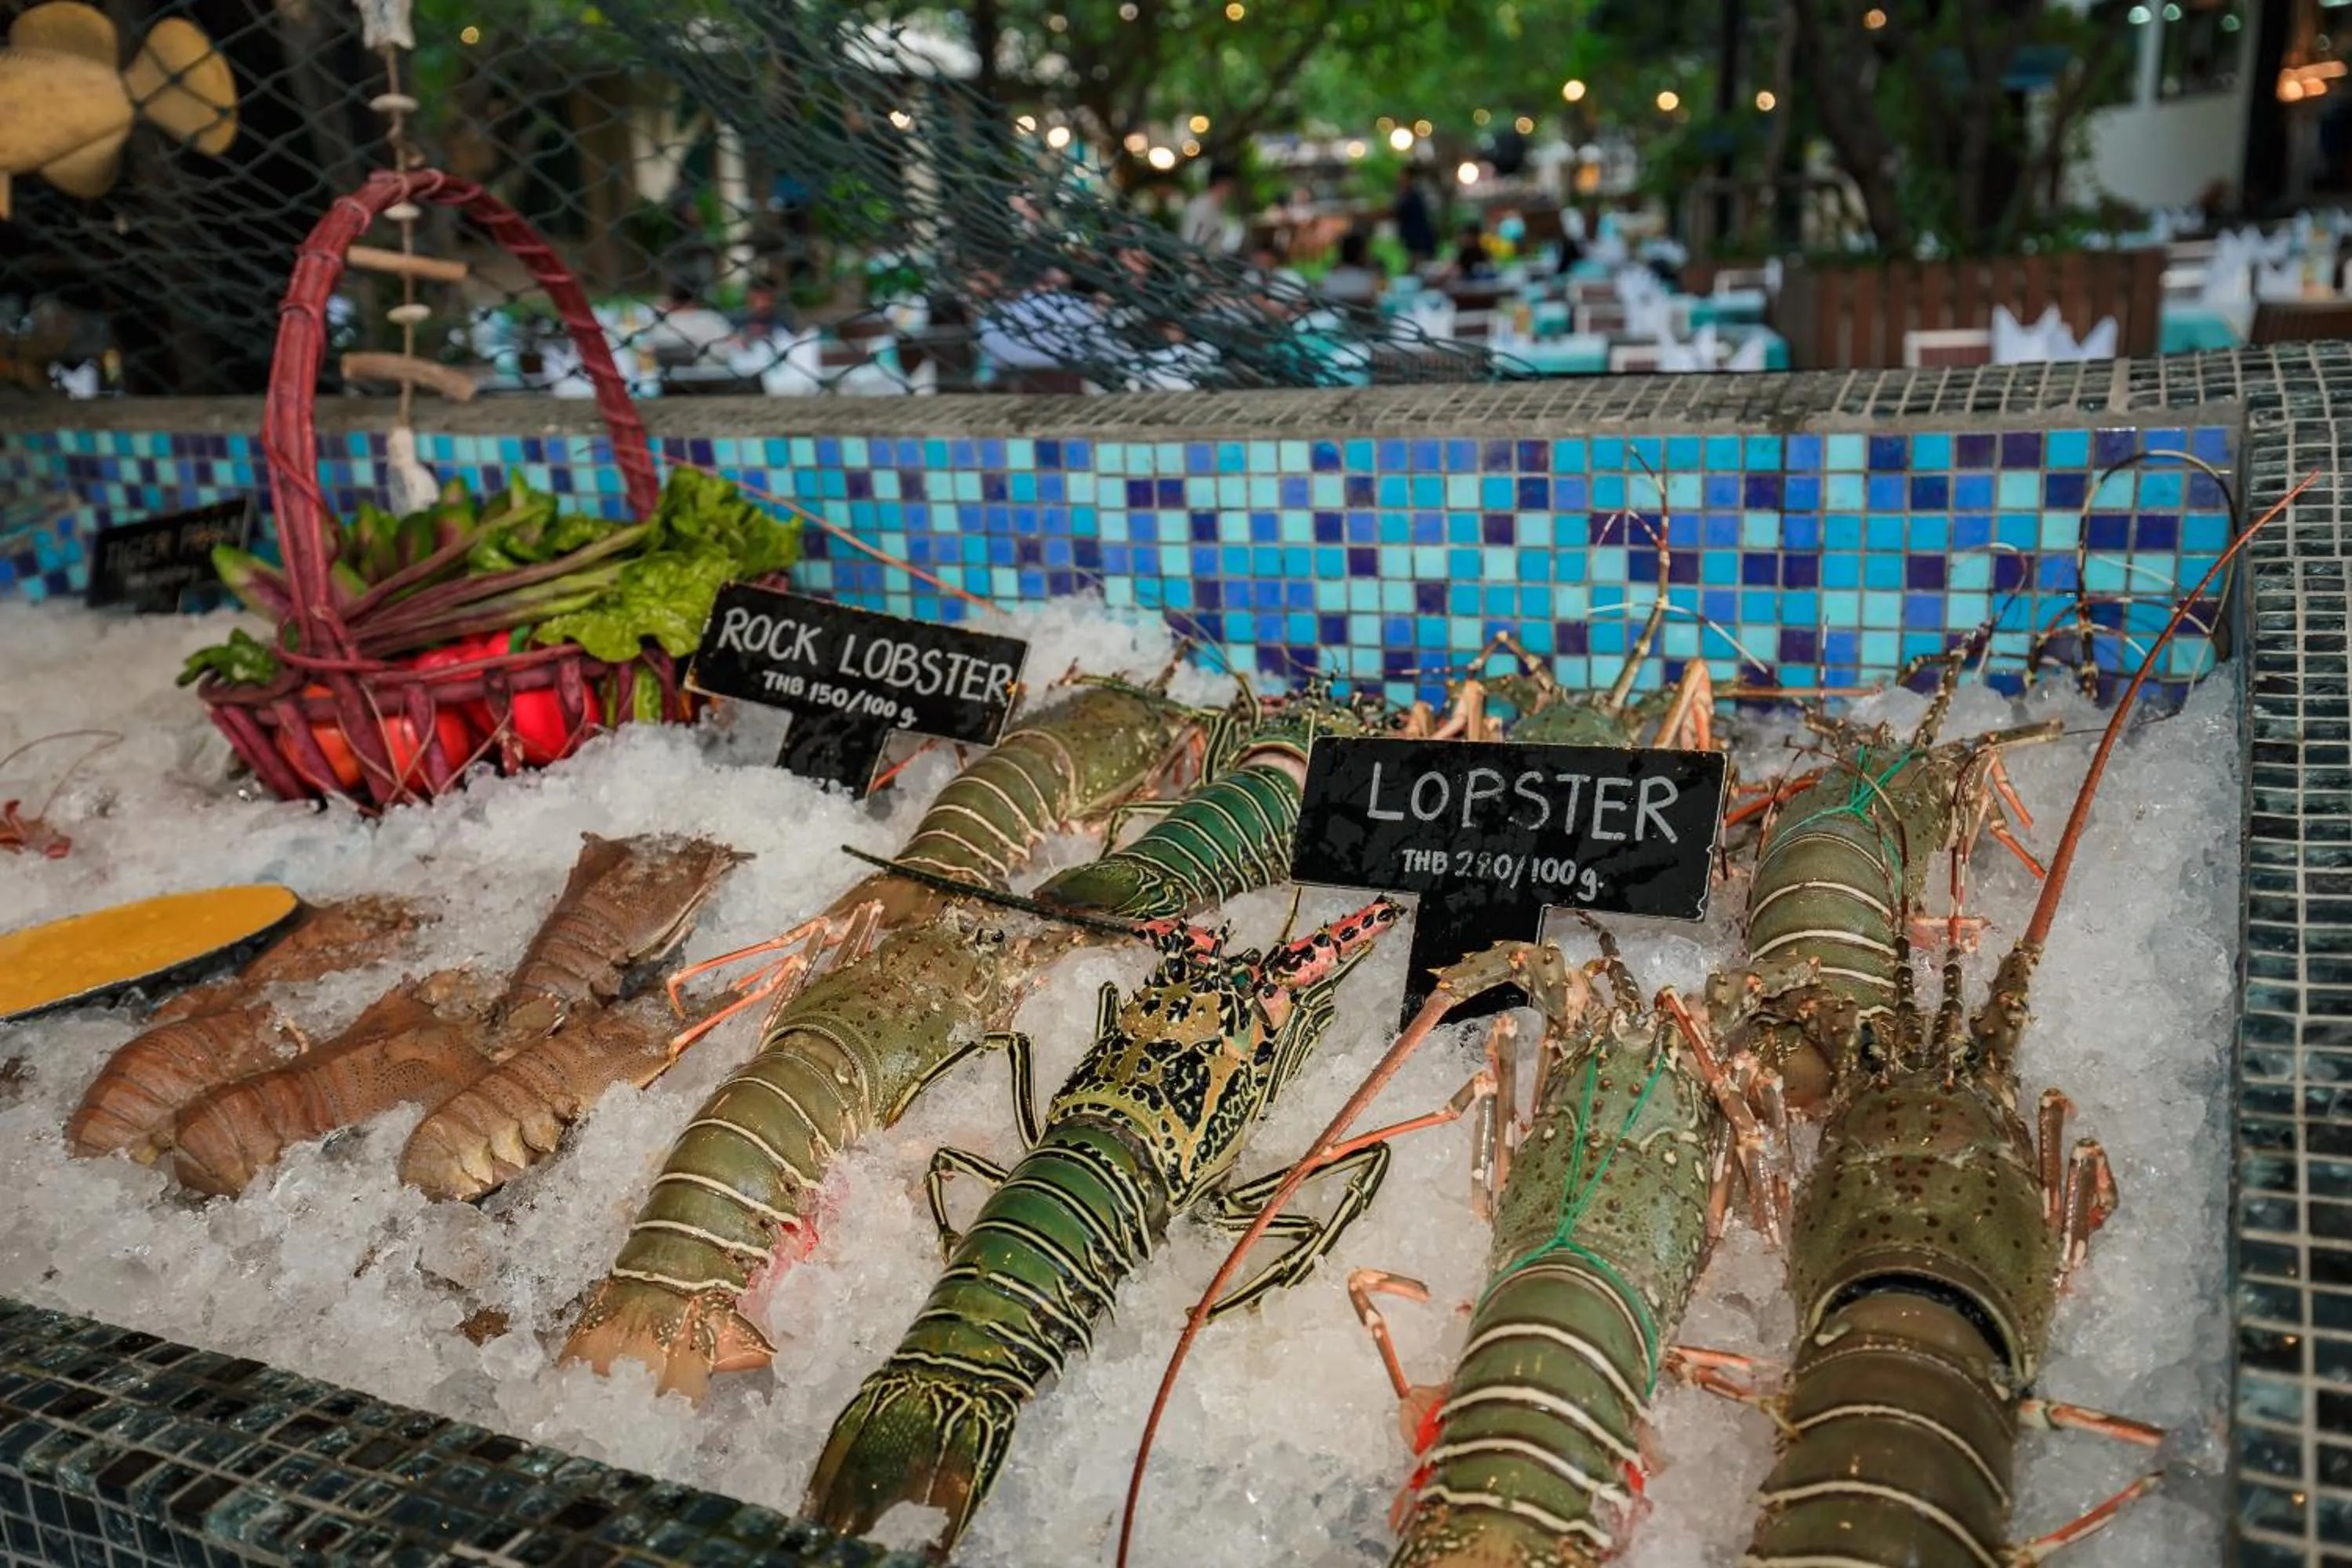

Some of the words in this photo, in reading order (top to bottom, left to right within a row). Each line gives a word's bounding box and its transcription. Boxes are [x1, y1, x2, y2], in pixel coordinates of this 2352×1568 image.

[717, 607, 822, 665] ROCK
[838, 633, 1012, 707] LOBSTER
[763, 670, 804, 696] THB
[1401, 849, 1448, 875] THB
